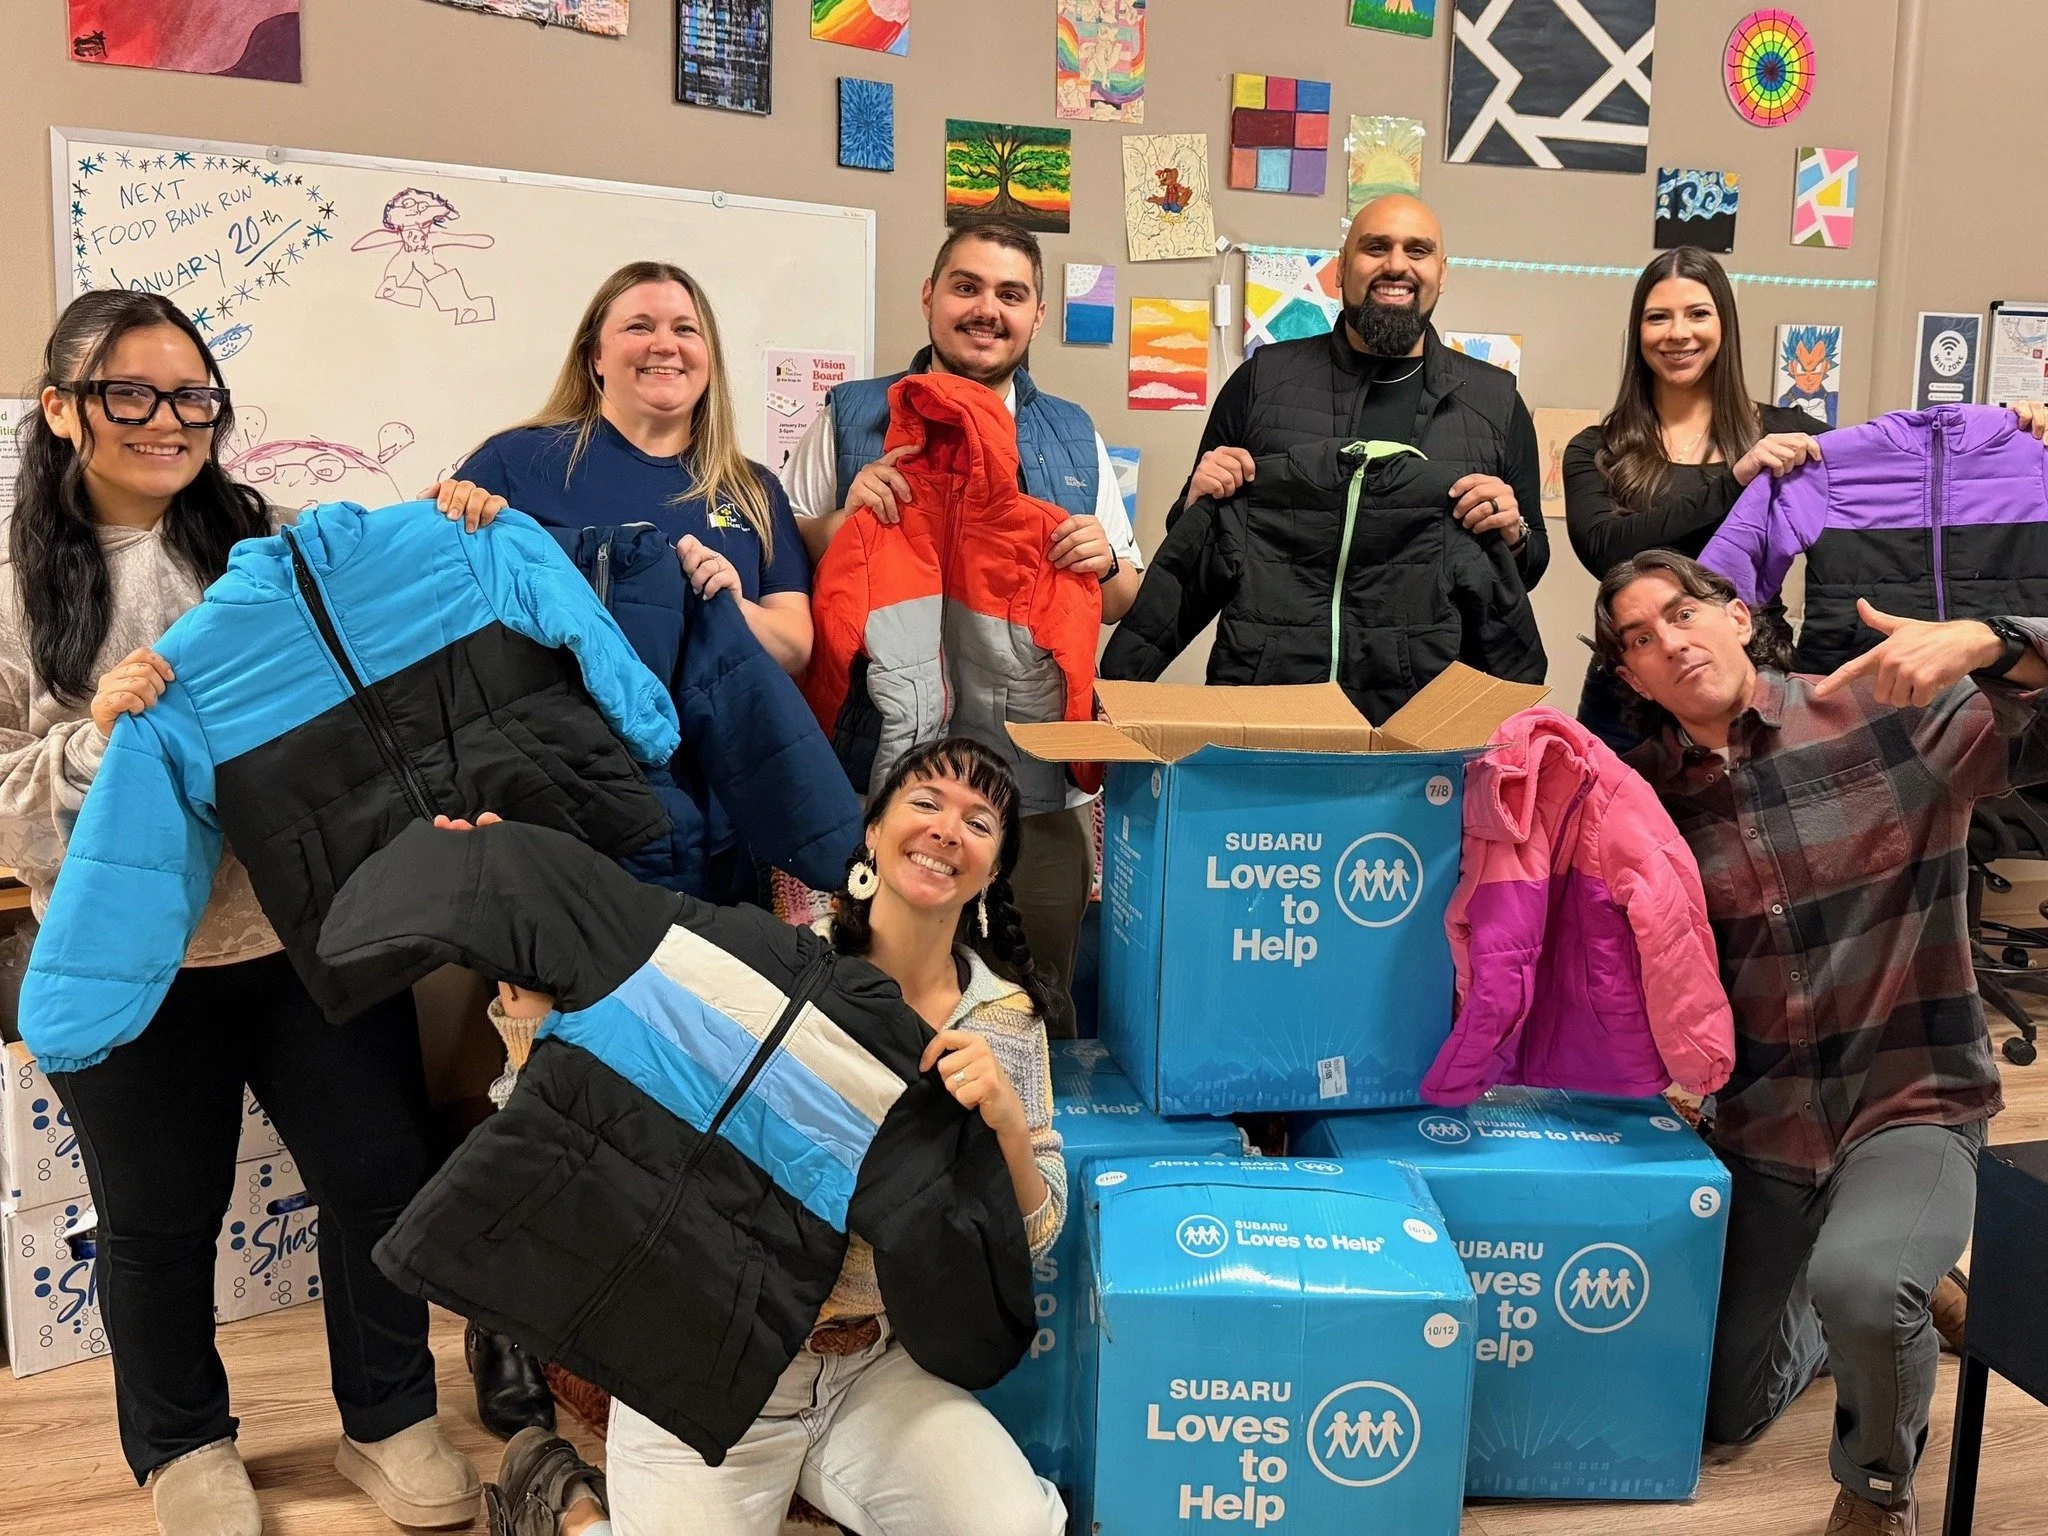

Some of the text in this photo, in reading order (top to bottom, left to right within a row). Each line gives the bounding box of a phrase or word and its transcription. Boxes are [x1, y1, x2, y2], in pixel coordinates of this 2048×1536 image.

[120, 178, 185, 209] NEXT
[91, 185, 252, 255] FOOD BANK RUN
[110, 209, 283, 294] JANUARY 20th
[812, 359, 846, 370] Vision
[812, 371, 844, 381] Board
[812, 382, 836, 391] Eve
[1429, 785, 1448, 797] 7/8
[1225, 832, 1322, 851] SUBARU
[1206, 856, 1321, 889] Loves
[1281, 894, 1319, 924] to
[1232, 928, 1318, 967] Help
[1066, 1105, 1088, 1115] to
[1473, 1120, 1526, 1129] SUBARU
[1477, 1126, 1543, 1139] Loves
[1545, 1129, 1568, 1141] to
[1698, 1193, 1713, 1212] S
[1234, 1219, 1288, 1232] SUBARU
[1236, 1229, 1301, 1248] Loves
[1304, 1233, 1328, 1249] to
[1453, 1240, 1544, 1260] UBARU
[1469, 1271, 1541, 1296] ves
[1497, 1300, 1538, 1329] to
[1427, 1326, 1454, 1336] 10/12
[1475, 1331, 1534, 1368] elp
[1169, 1378, 1291, 1402] SUBARU
[1147, 1404, 1290, 1444] Loves
[1239, 1449, 1288, 1483] to
[1178, 1484, 1286, 1528] Help
